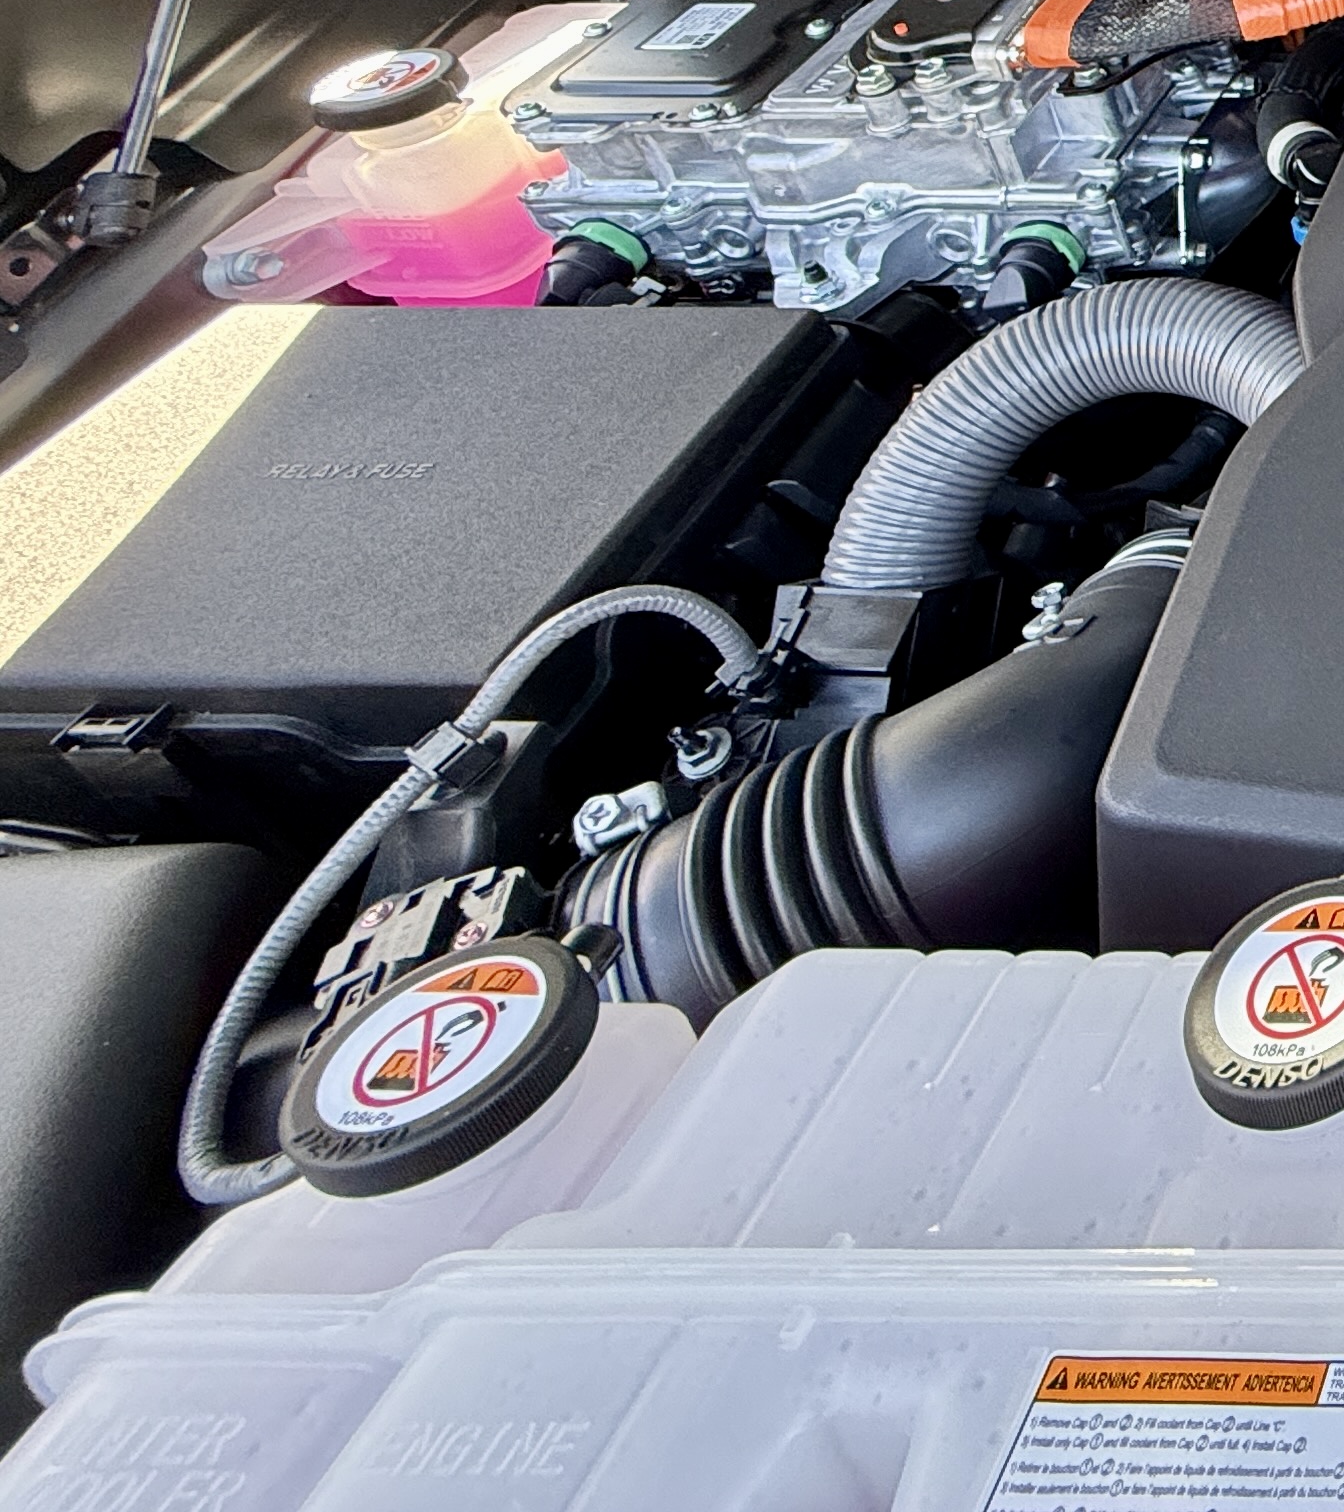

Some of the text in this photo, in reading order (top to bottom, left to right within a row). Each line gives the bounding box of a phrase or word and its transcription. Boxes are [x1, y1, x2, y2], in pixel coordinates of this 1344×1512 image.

[265, 463, 348, 479] RELAY
[366, 462, 434, 479] FUSE
[1252, 1043, 1306, 1057] 108kPa
[1213, 1055, 1325, 1089] DENSO
[1074, 1371, 1315, 1393] WARNING AVERTISSEMENT ADVERTENCIA
[361, 1420, 590, 1476] ENGINE
